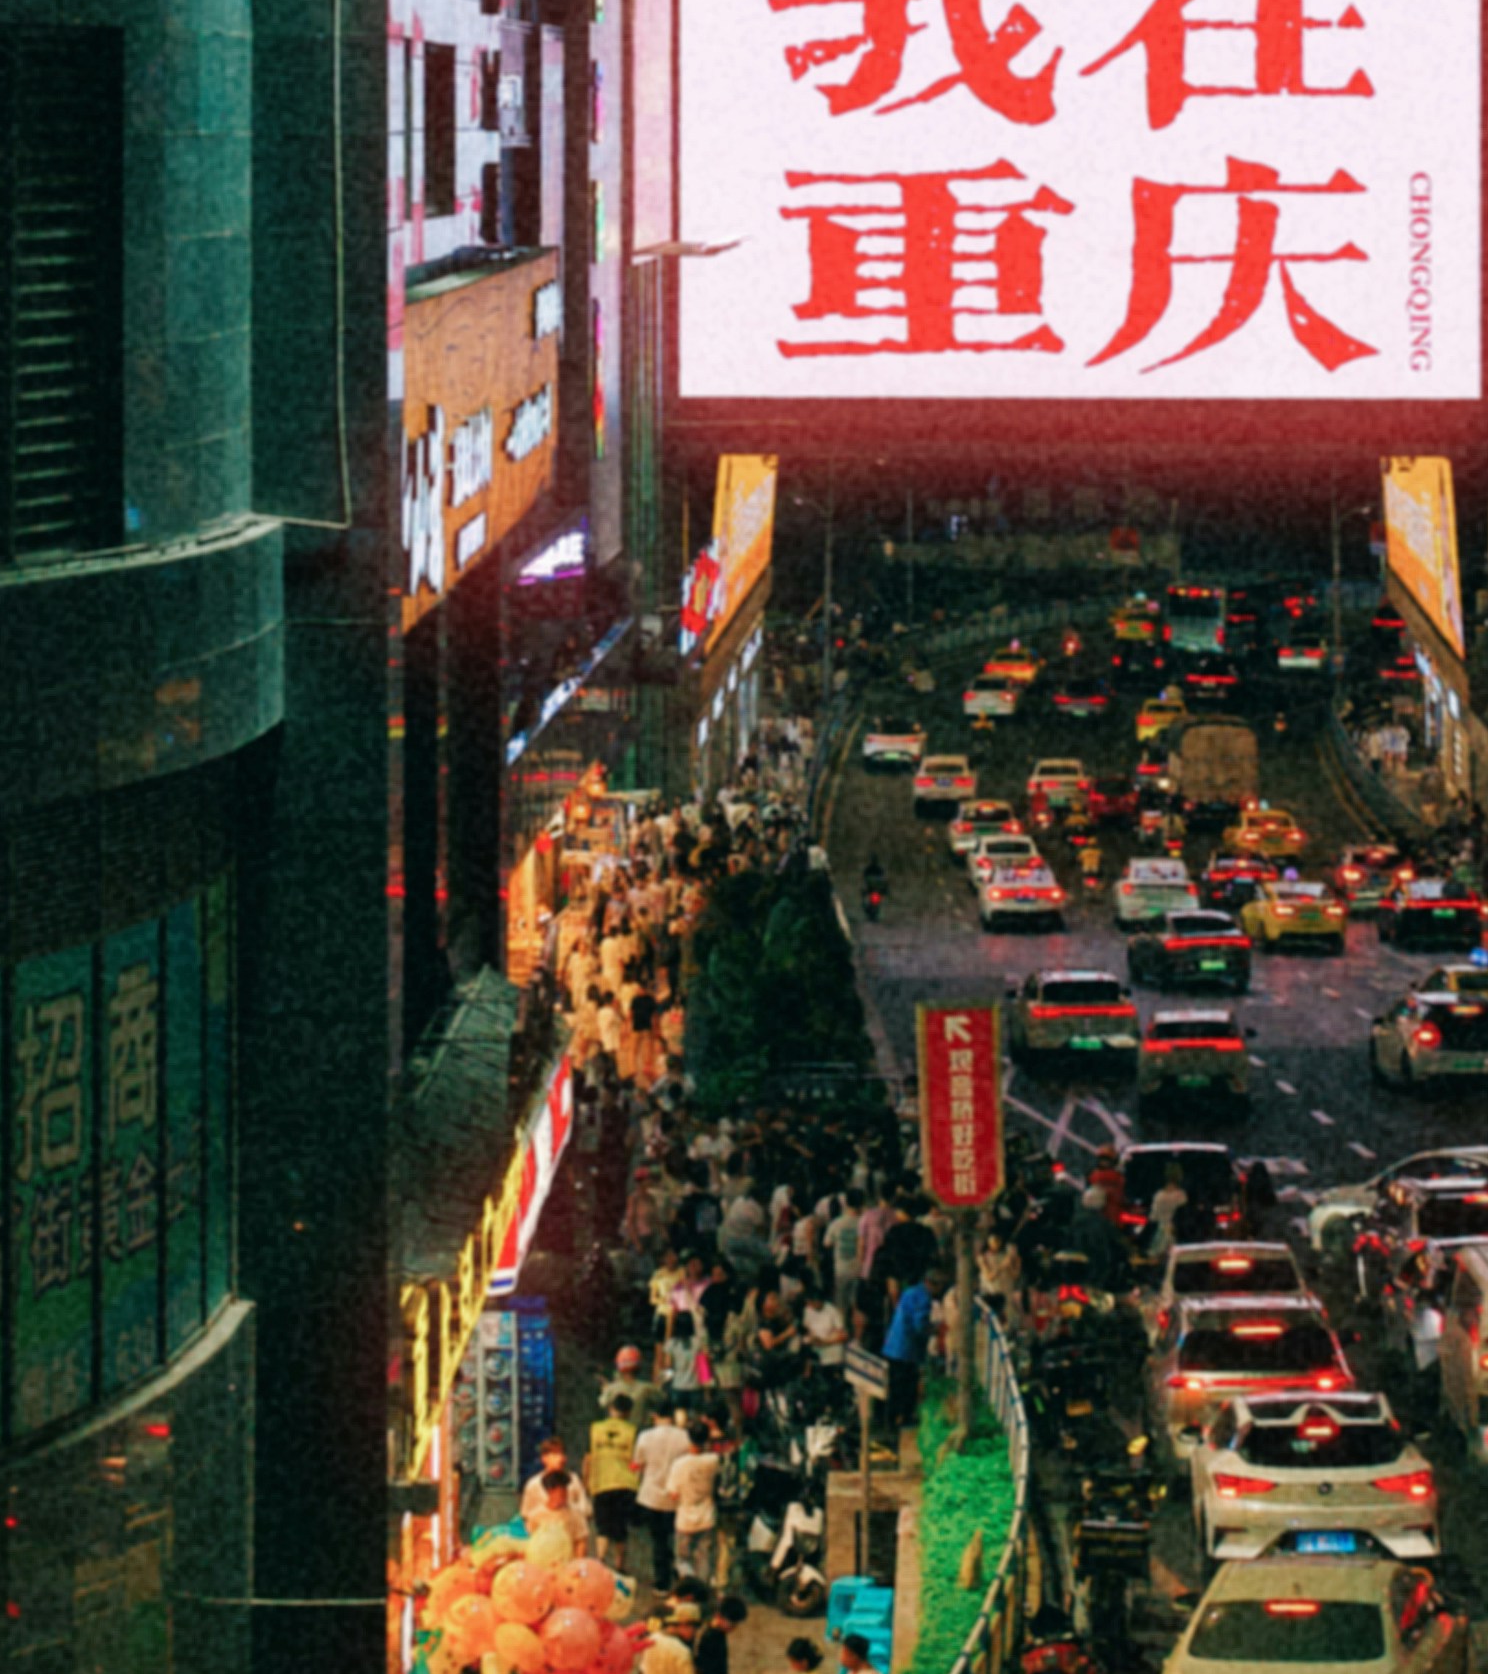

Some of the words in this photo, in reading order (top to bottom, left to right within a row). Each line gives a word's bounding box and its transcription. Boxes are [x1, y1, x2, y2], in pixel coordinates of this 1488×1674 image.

[774, 154, 1380, 375] 重庆
[1406, 171, 1433, 373] CHONGQING
[17, 962, 158, 1181] 招商
